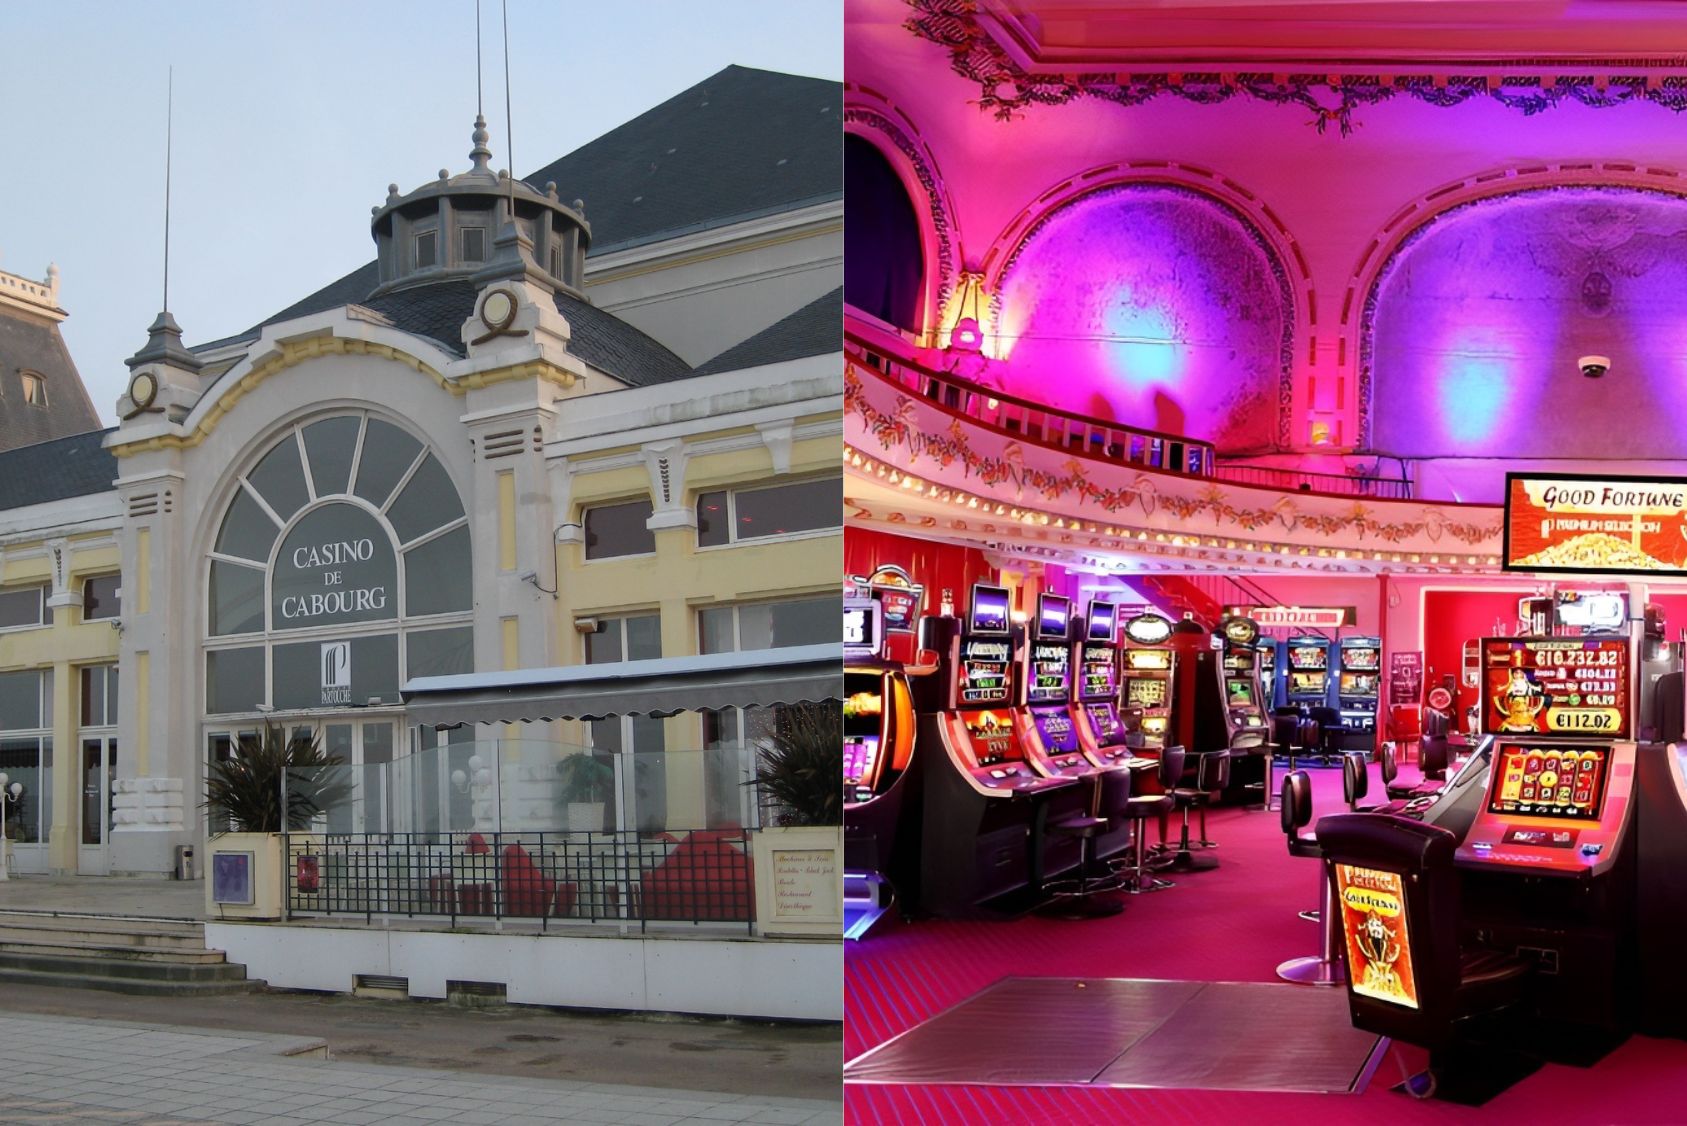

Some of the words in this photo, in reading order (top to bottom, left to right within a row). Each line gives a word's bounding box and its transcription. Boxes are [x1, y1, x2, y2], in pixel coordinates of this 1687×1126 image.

[293, 538, 374, 569] CASINO
[324, 571, 343, 586] DE
[281, 586, 386, 619] CABOURG
